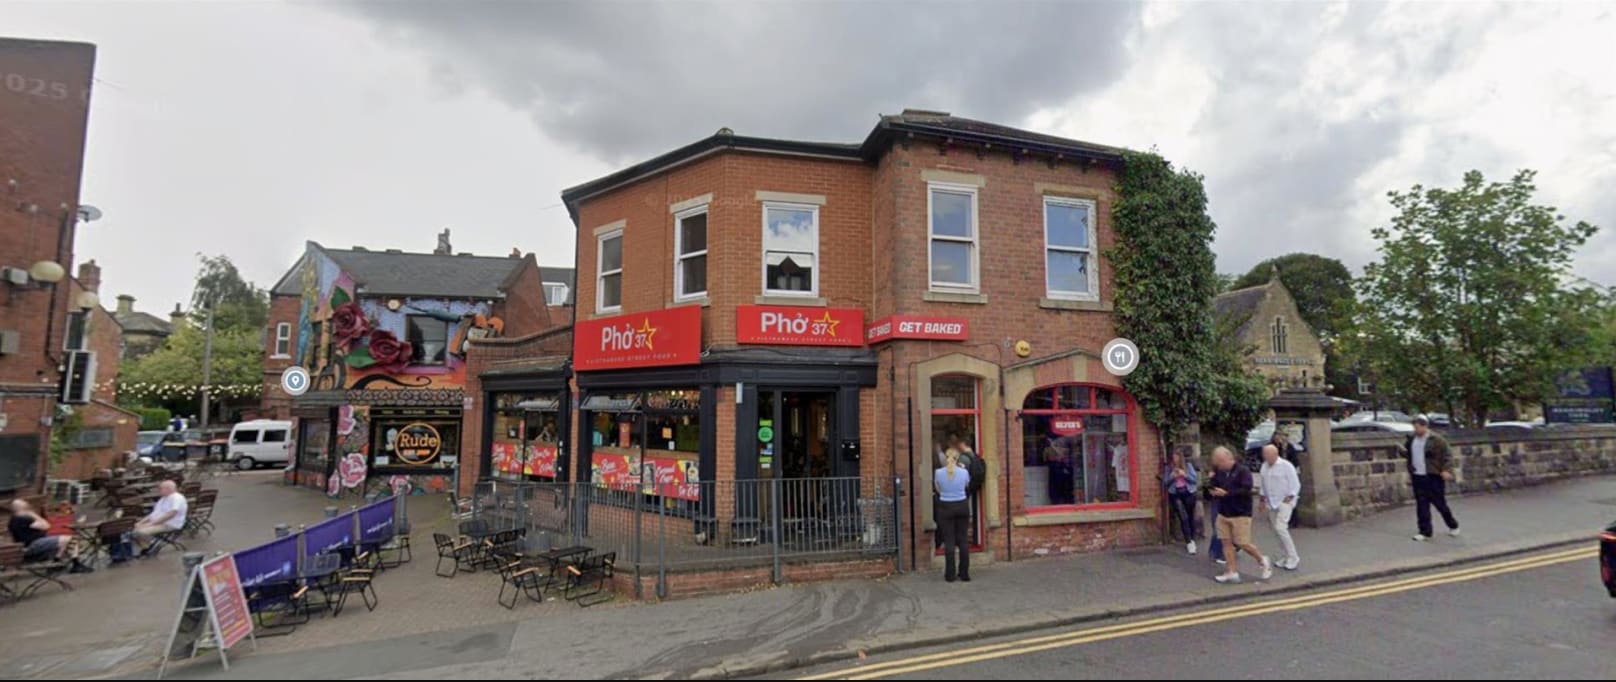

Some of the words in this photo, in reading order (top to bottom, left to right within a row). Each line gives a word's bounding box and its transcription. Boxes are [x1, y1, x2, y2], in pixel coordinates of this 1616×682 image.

[761, 311, 809, 334] Phở
[811, 323, 828, 335] 37
[899, 321, 923, 334] GET
[924, 322, 961, 335] BAKED
[602, 323, 635, 351] Phở
[635, 334, 647, 348] 37
[399, 432, 438, 448] Rude
